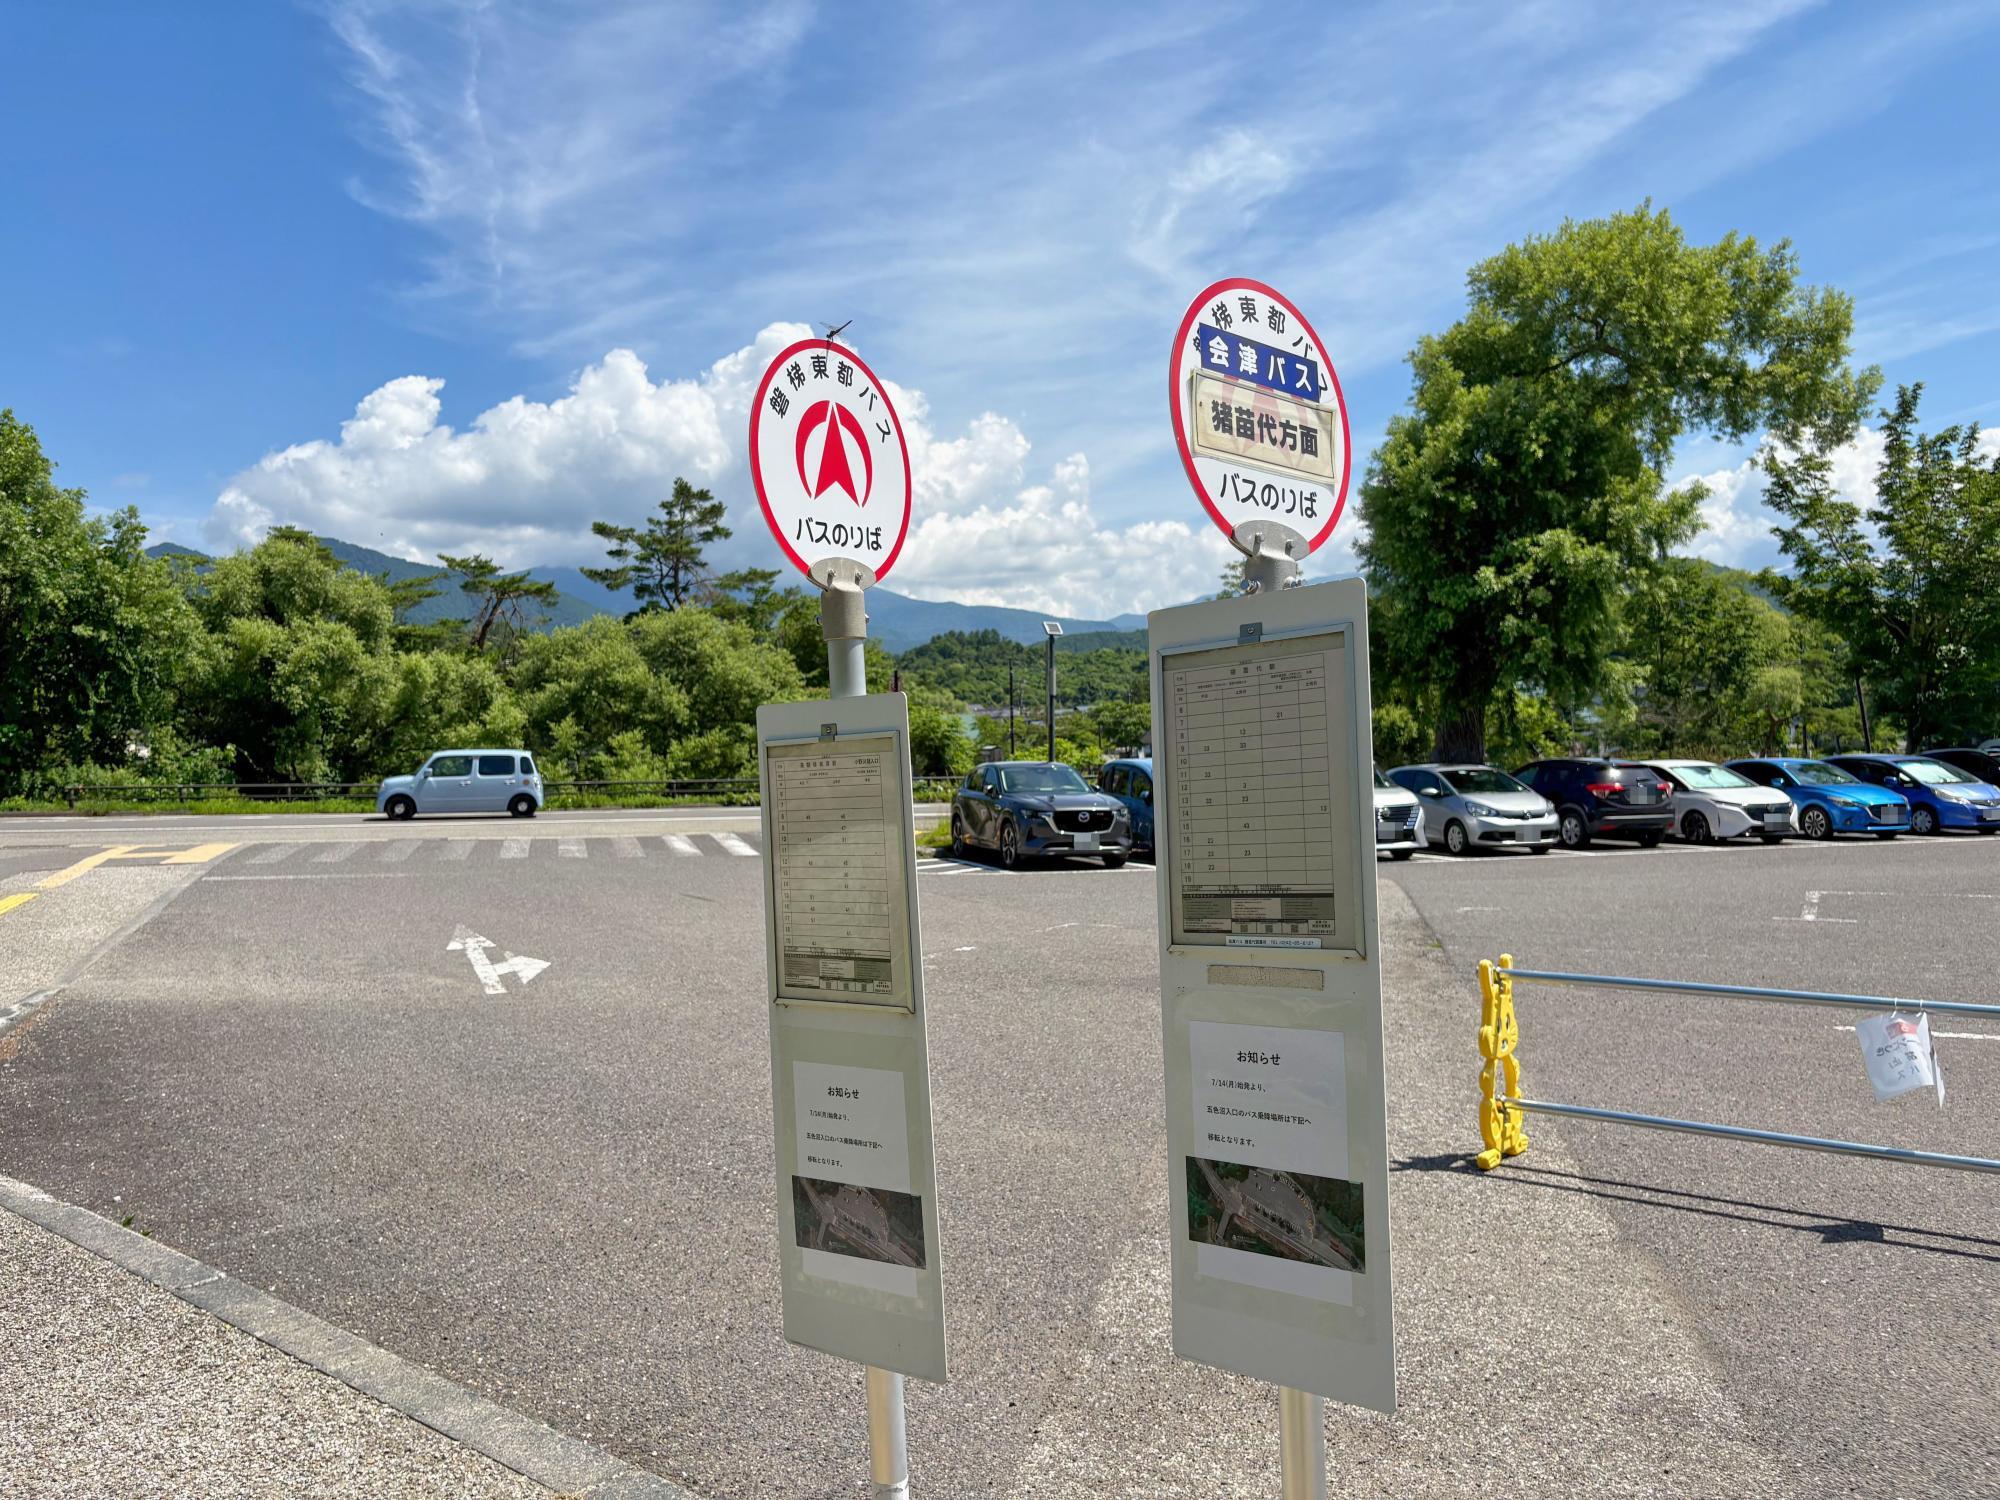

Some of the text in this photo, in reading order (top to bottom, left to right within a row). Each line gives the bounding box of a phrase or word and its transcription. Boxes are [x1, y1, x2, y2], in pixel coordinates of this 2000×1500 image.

[1208, 335, 1312, 393] 会津バス
[769, 354, 892, 443] 磐梯東都バス
[1211, 399, 1319, 458] 猪苗代方面
[1220, 473, 1317, 519] バスのりば
[796, 517, 882, 552] バスのりば
[1237, 1050, 1281, 1066] お知らせ
[827, 1086, 860, 1100] お知らせ
